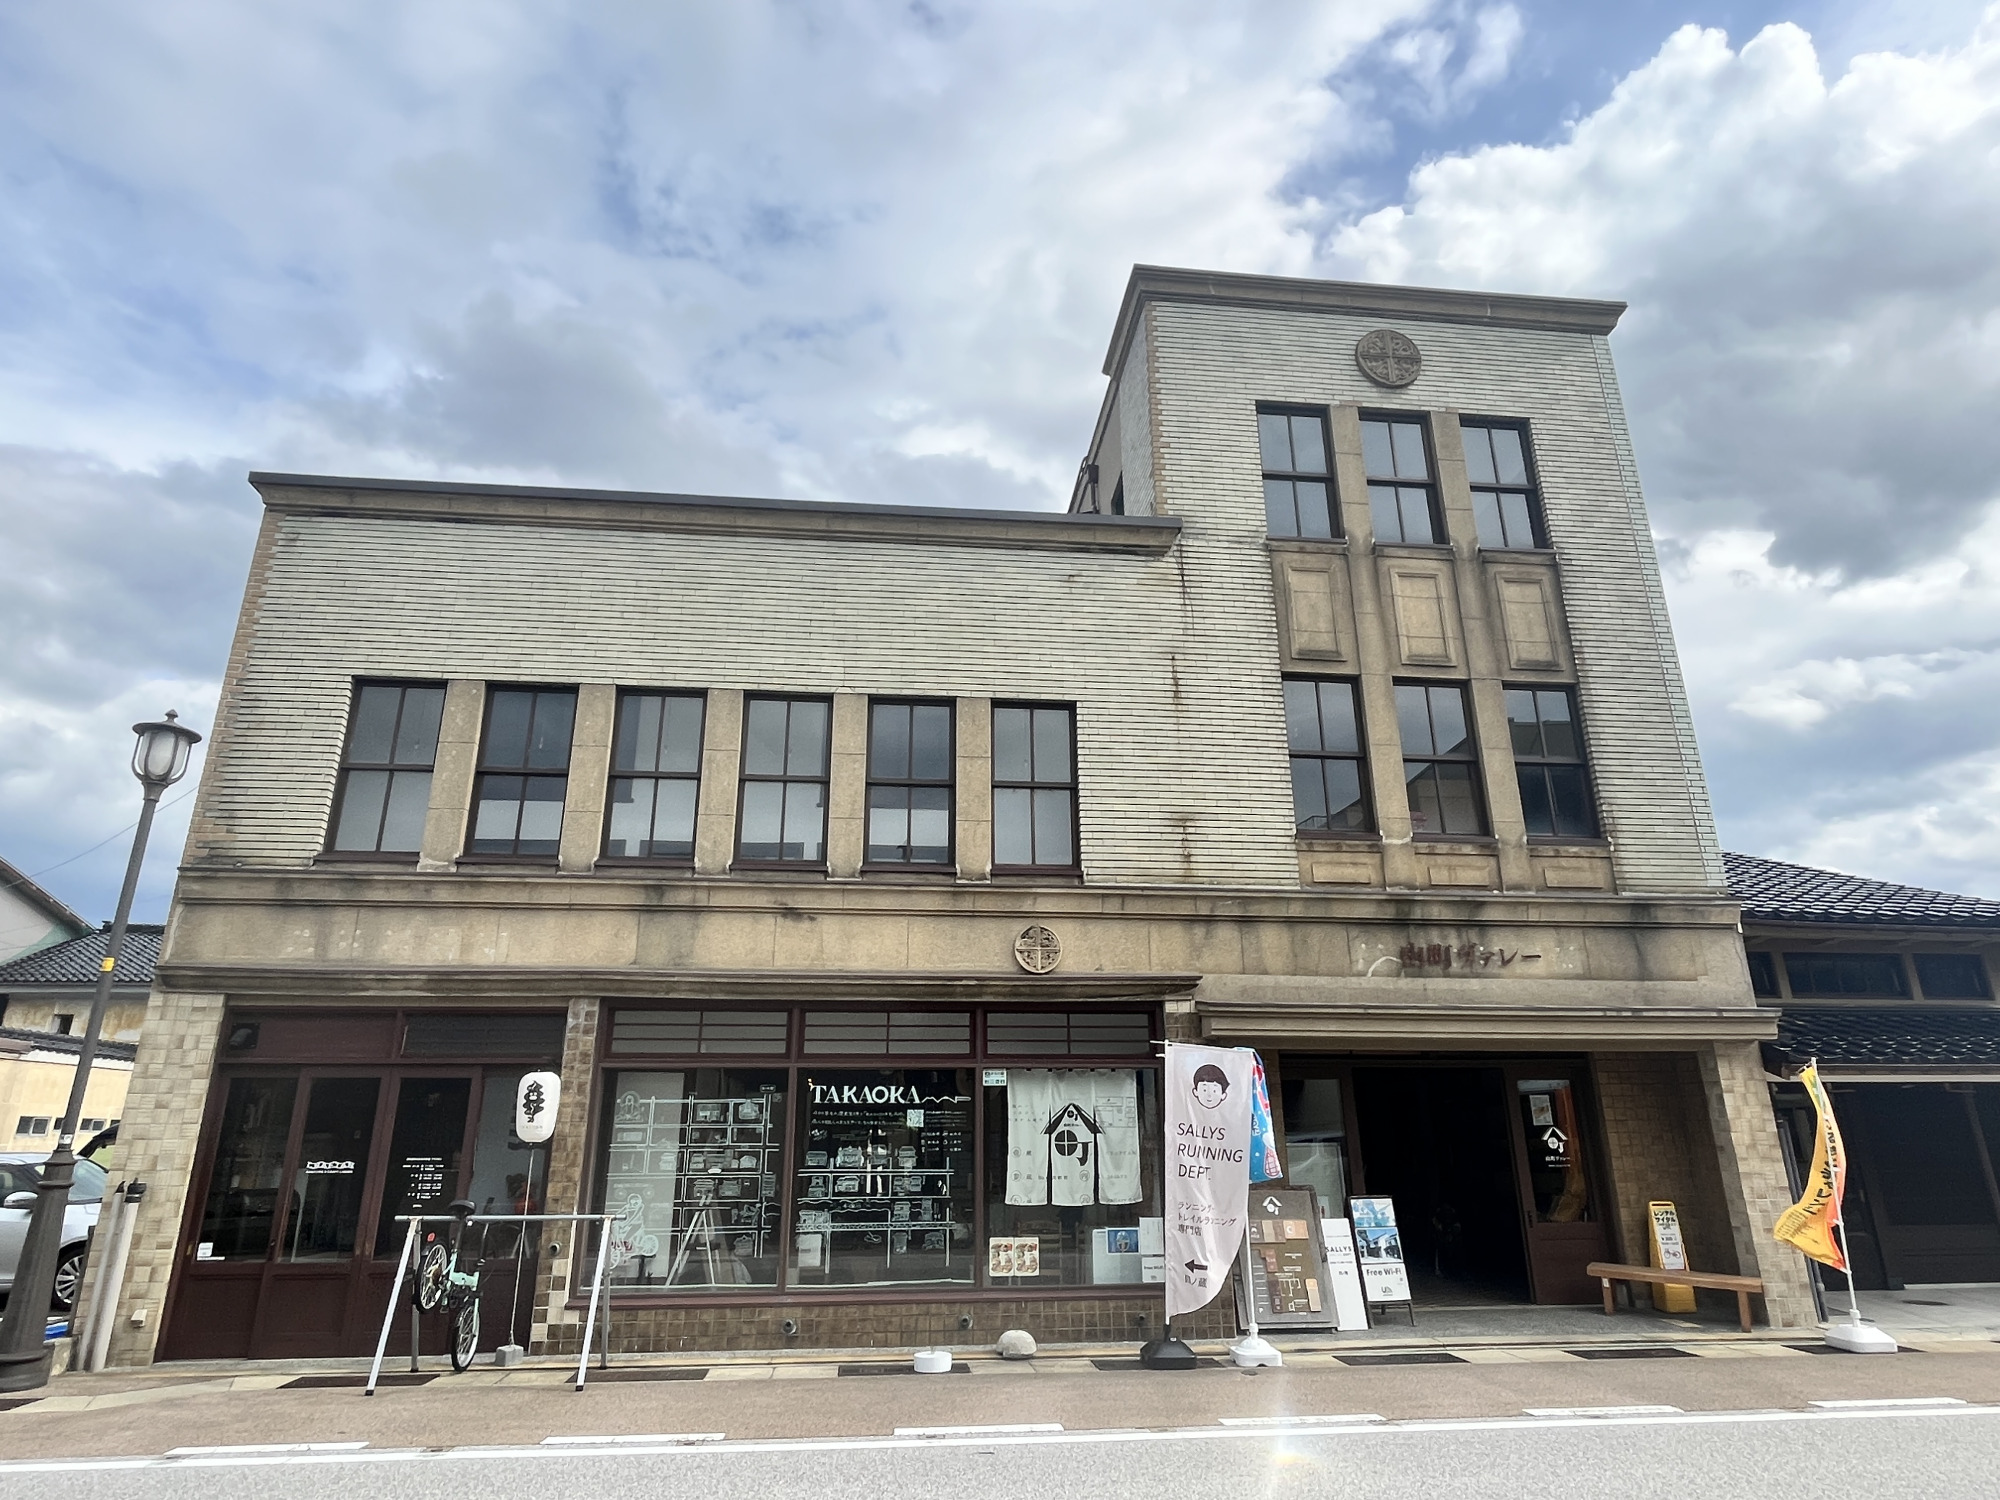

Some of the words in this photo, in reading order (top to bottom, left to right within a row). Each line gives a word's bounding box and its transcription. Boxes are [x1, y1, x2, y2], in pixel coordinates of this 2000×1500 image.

[812, 1085, 922, 1104] TAKAOKA
[1176, 1122, 1226, 1141] SALLYS
[1177, 1143, 1244, 1163] RUNNING
[1178, 1163, 1212, 1181] DEPT.
[1366, 1268, 1383, 1276] Free
